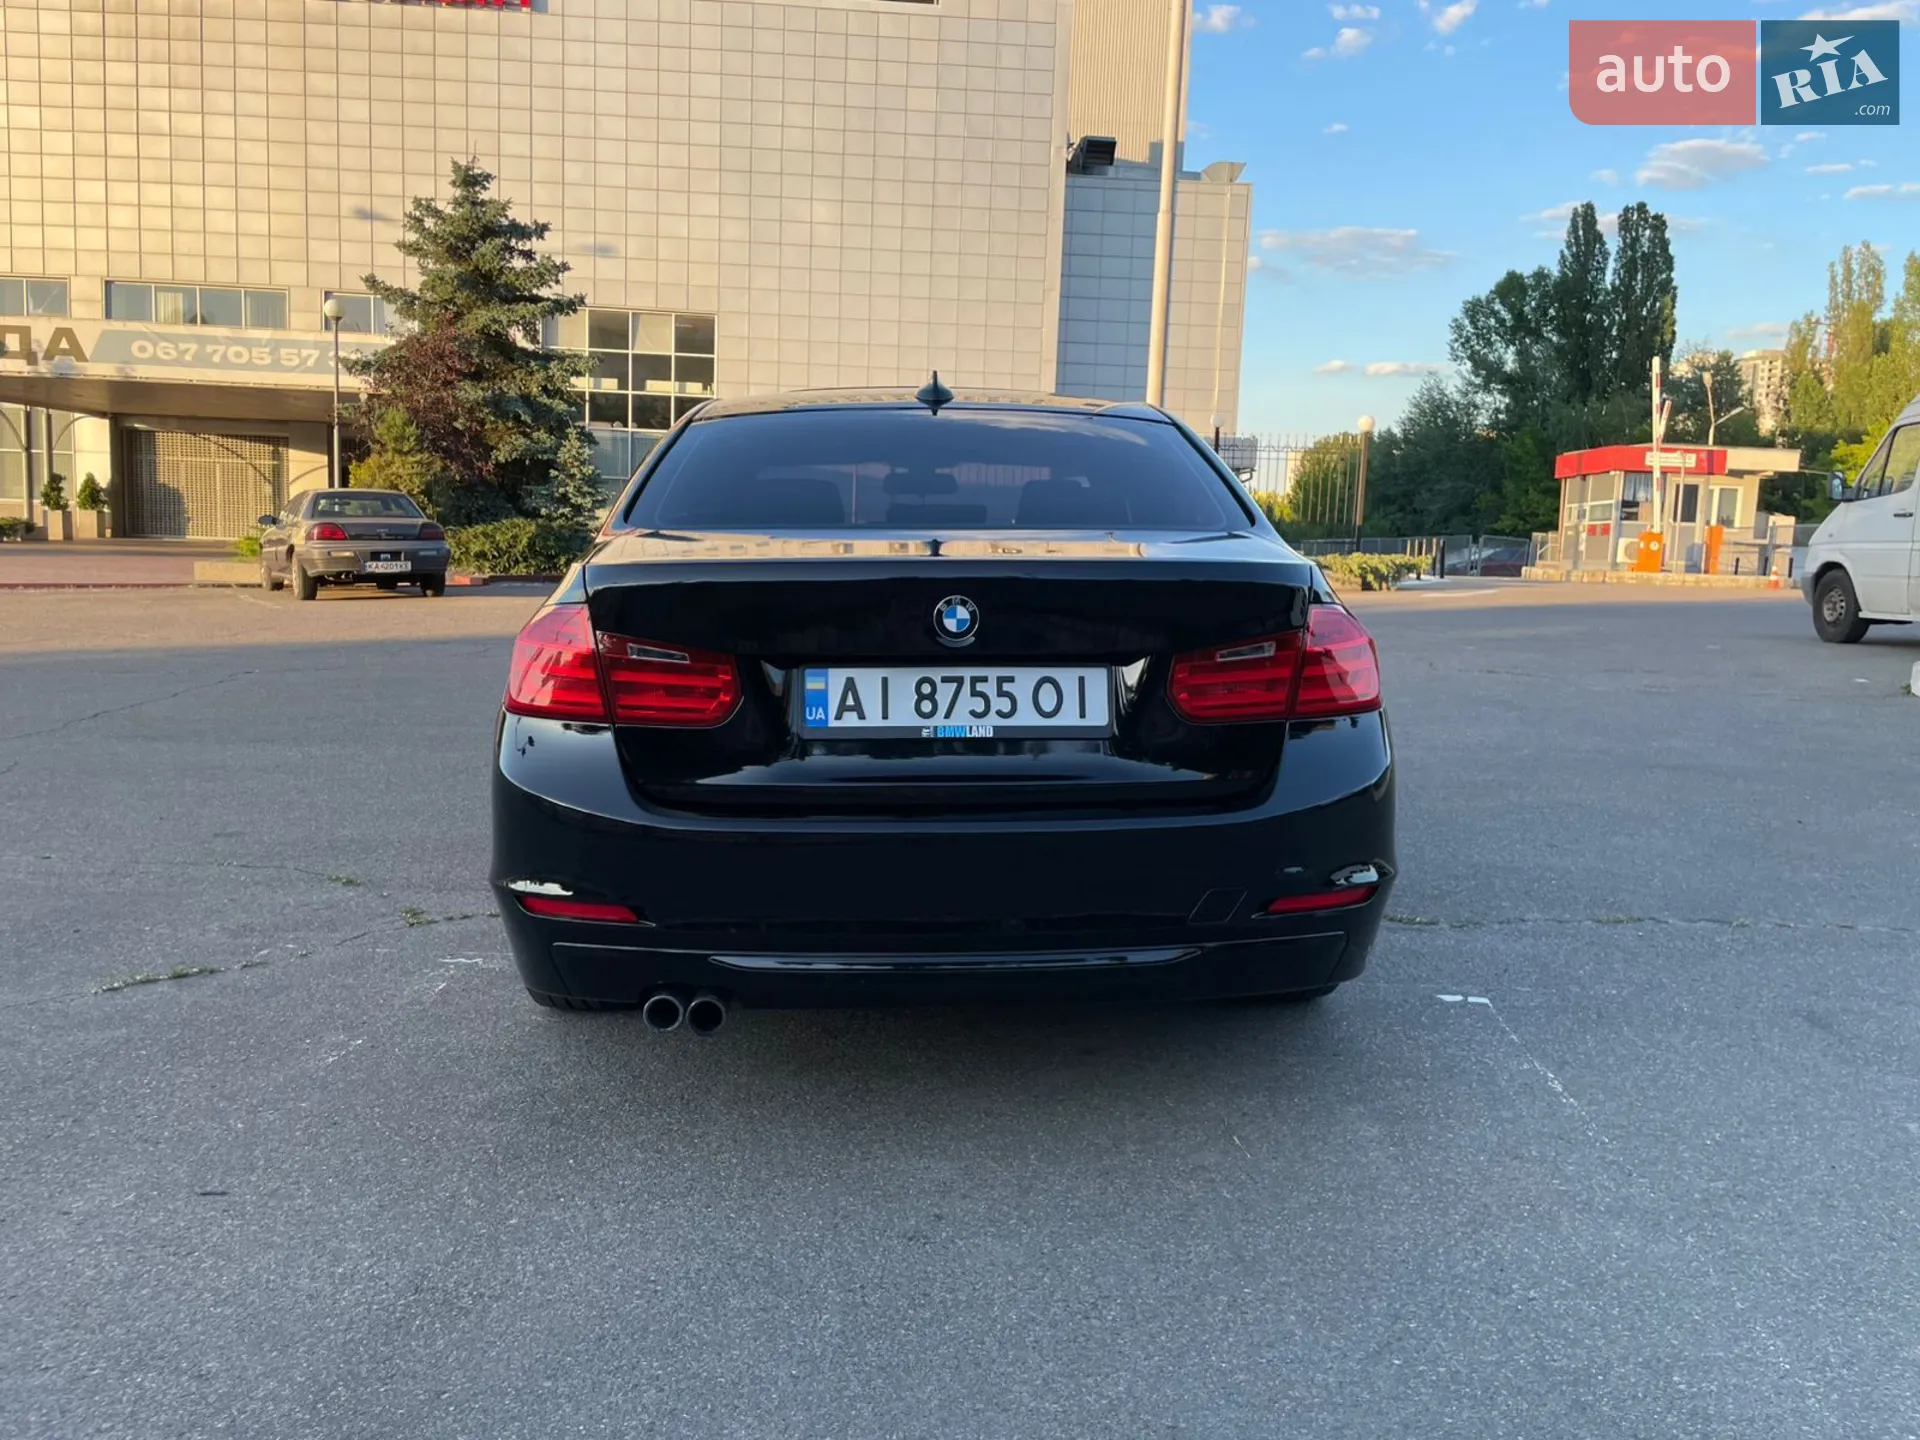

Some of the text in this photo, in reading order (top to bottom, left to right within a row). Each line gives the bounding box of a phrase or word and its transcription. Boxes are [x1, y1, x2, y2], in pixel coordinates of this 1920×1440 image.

[131, 339, 199, 361] 067
[205, 344, 272, 366] 705
[279, 348, 321, 367] 57
[940, 596, 975, 611] BMW
[833, 676, 1087, 720] AI 8755 OI
[805, 707, 826, 720] UA
[937, 725, 994, 738] BMWLAND
